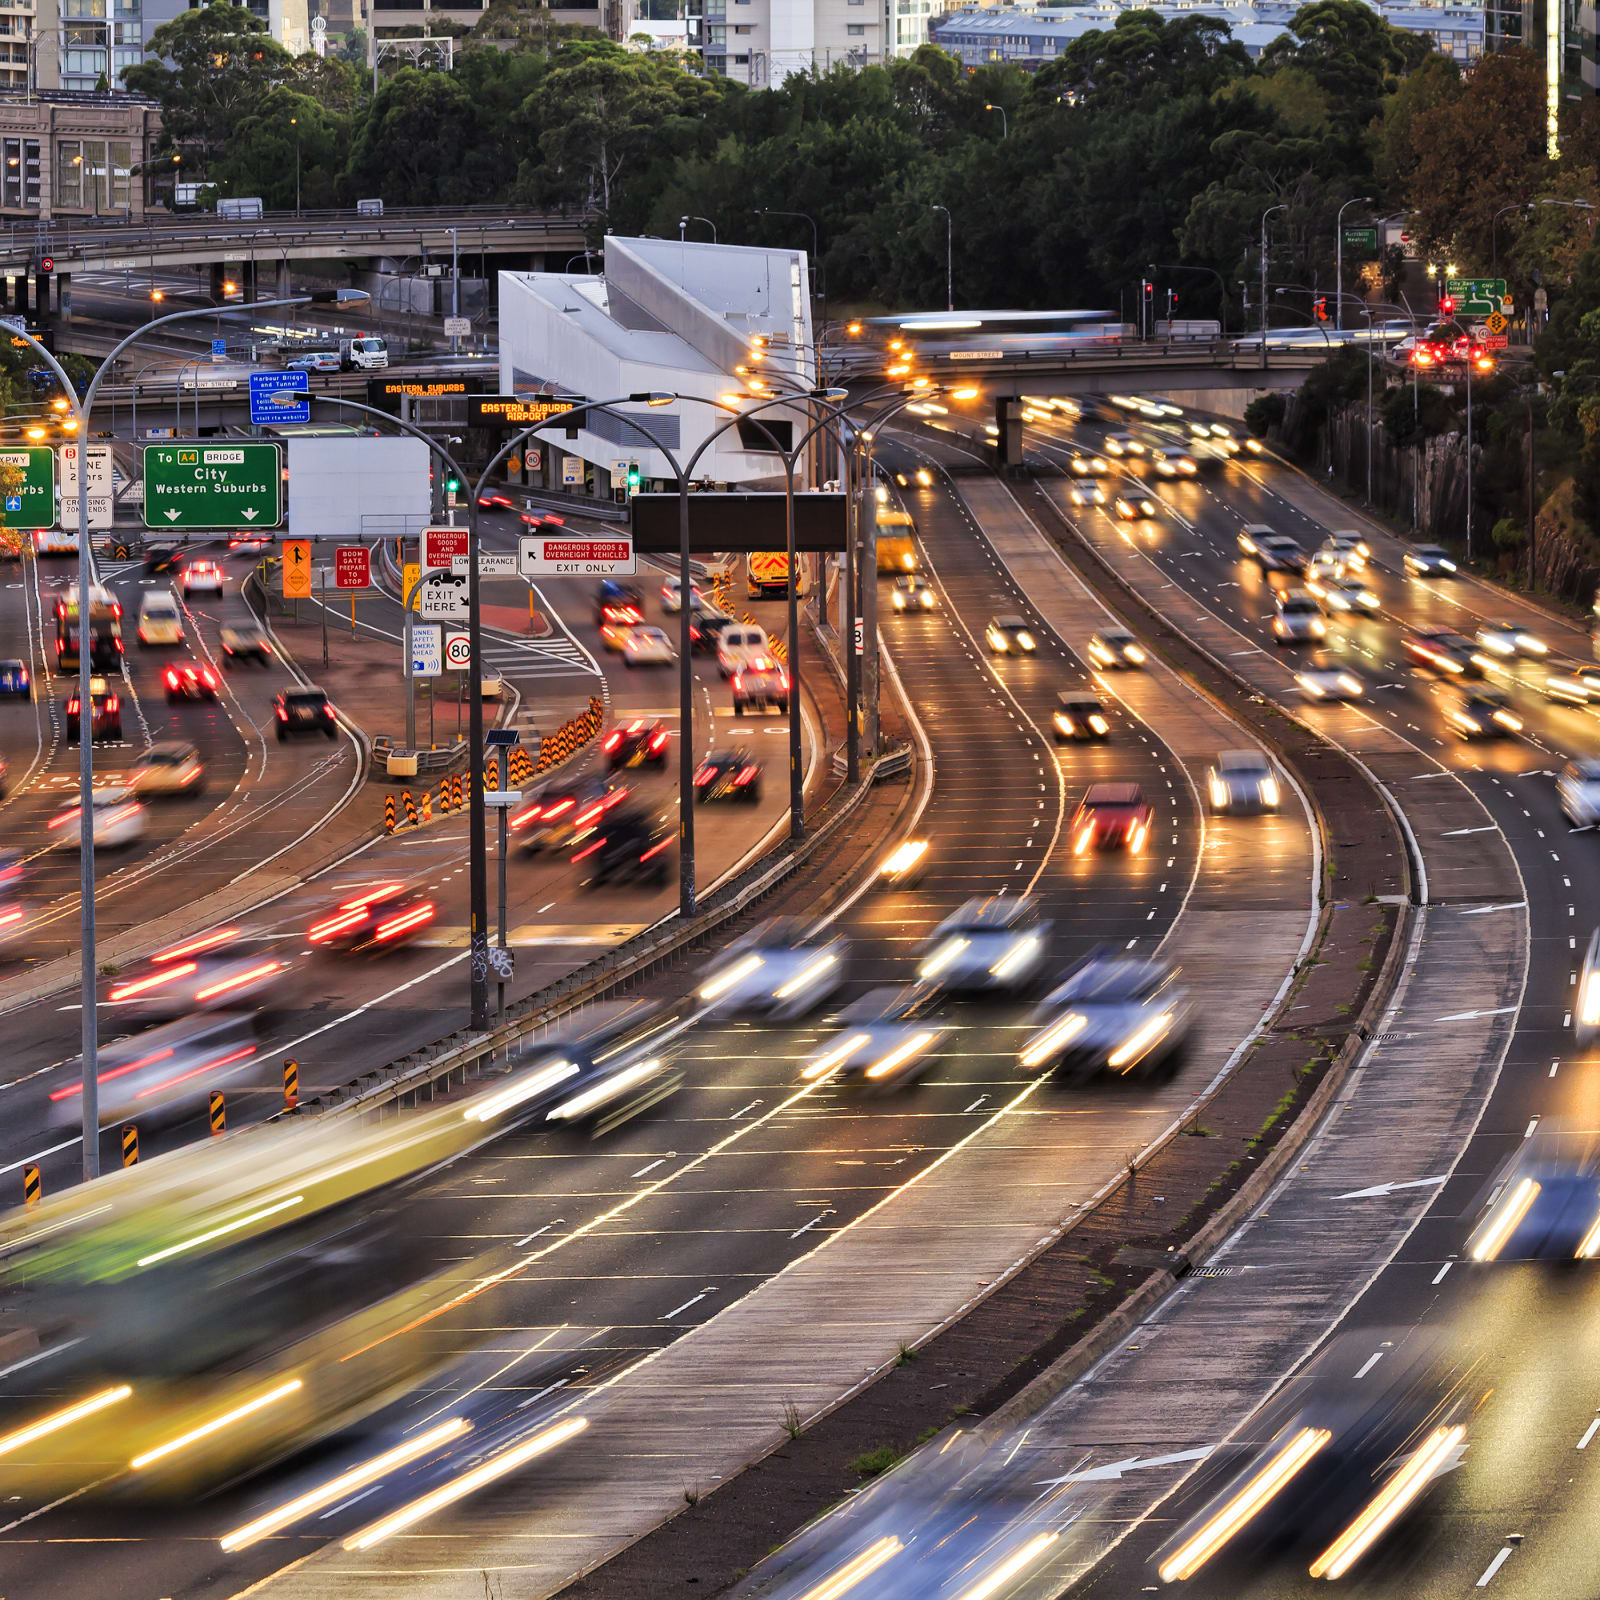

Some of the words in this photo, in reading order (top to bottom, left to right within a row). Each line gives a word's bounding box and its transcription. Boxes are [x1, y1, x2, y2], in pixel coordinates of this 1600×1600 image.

[385, 385, 423, 393] EASTERN
[427, 384, 465, 392] SUBURBS
[481, 403, 524, 413] EASTERN
[529, 403, 573, 413] SUBURBS
[506, 412, 548, 421] AIRPORT
[158, 453, 172, 463] To
[181, 453, 196, 462] A4
[206, 453, 241, 461] BRIDGE
[528, 456, 538, 464] 80
[69, 461, 102, 470] LNE
[194, 467, 228, 482] City
[155, 484, 207, 494] Western
[214, 483, 267, 493] Suburbs
[556, 564, 580, 572] EXIT
[585, 564, 615, 572] ONLY
[427, 591, 454, 600] EXIT
[425, 603, 456, 611] HERE
[451, 644, 470, 657] 80
